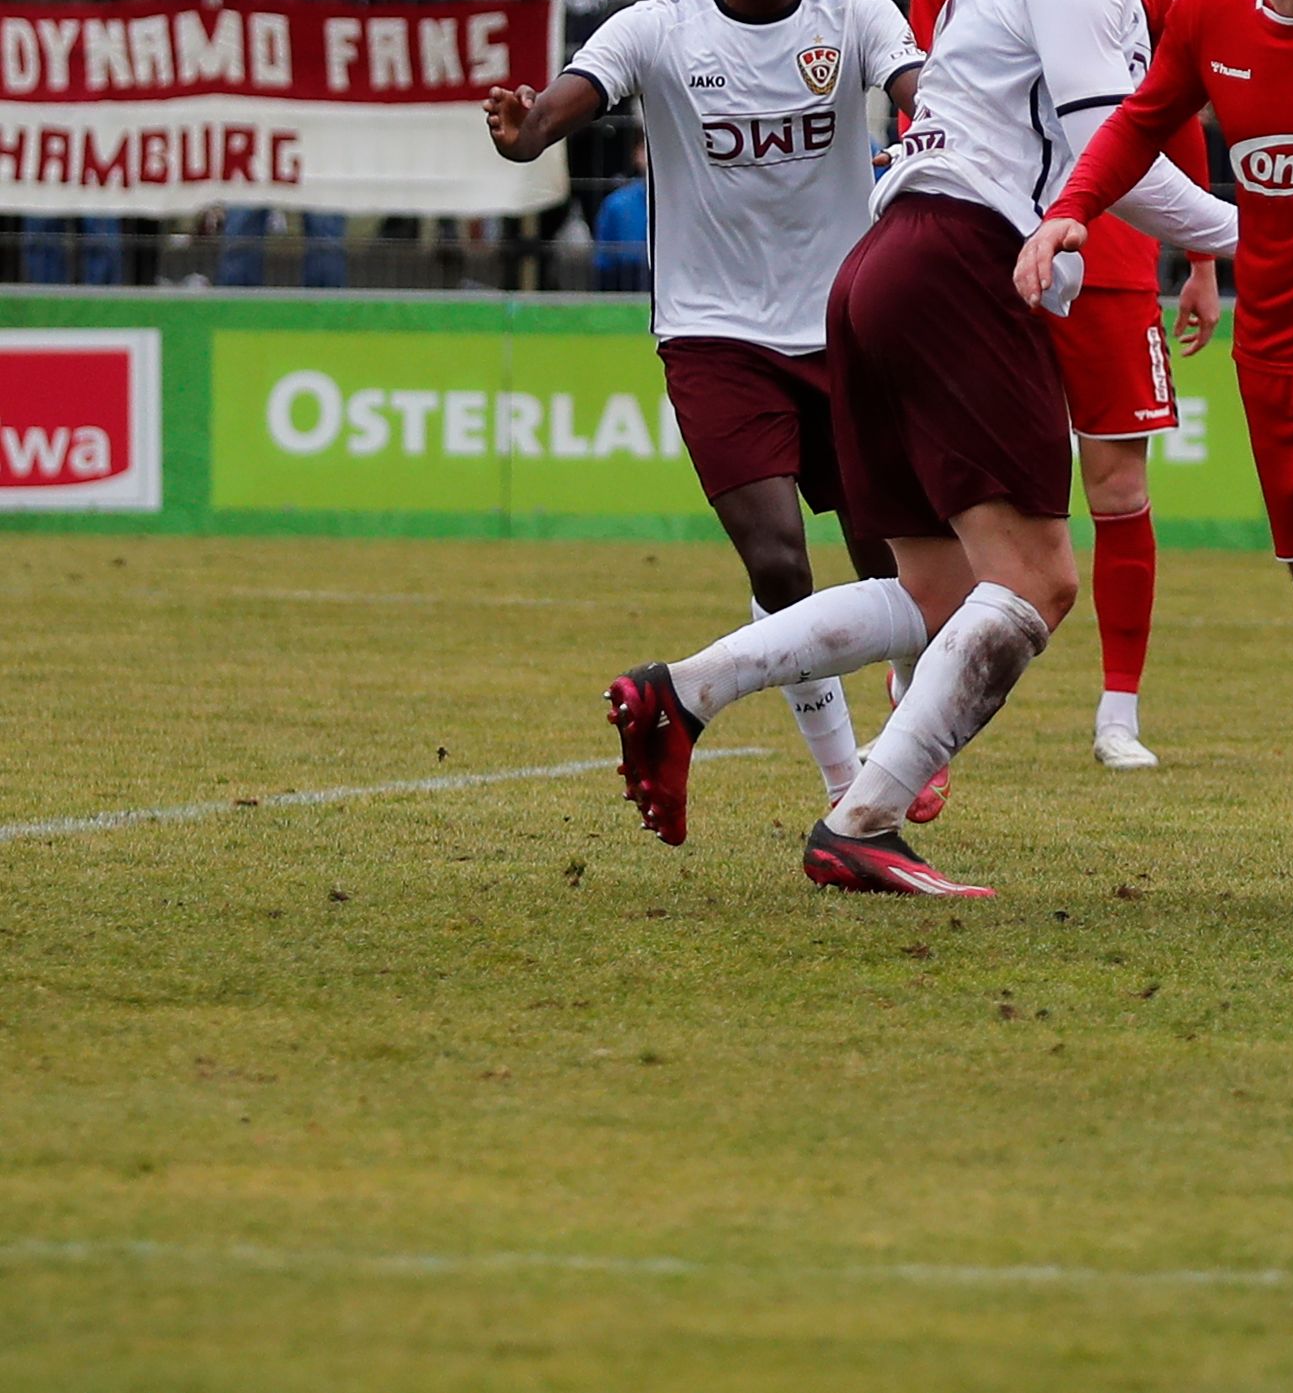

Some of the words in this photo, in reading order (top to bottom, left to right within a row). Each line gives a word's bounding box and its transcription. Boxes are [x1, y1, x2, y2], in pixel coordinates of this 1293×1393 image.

[2, 10, 293, 95] DYNAMO
[323, 11, 512, 93] FANS
[688, 75, 726, 89] JAKO
